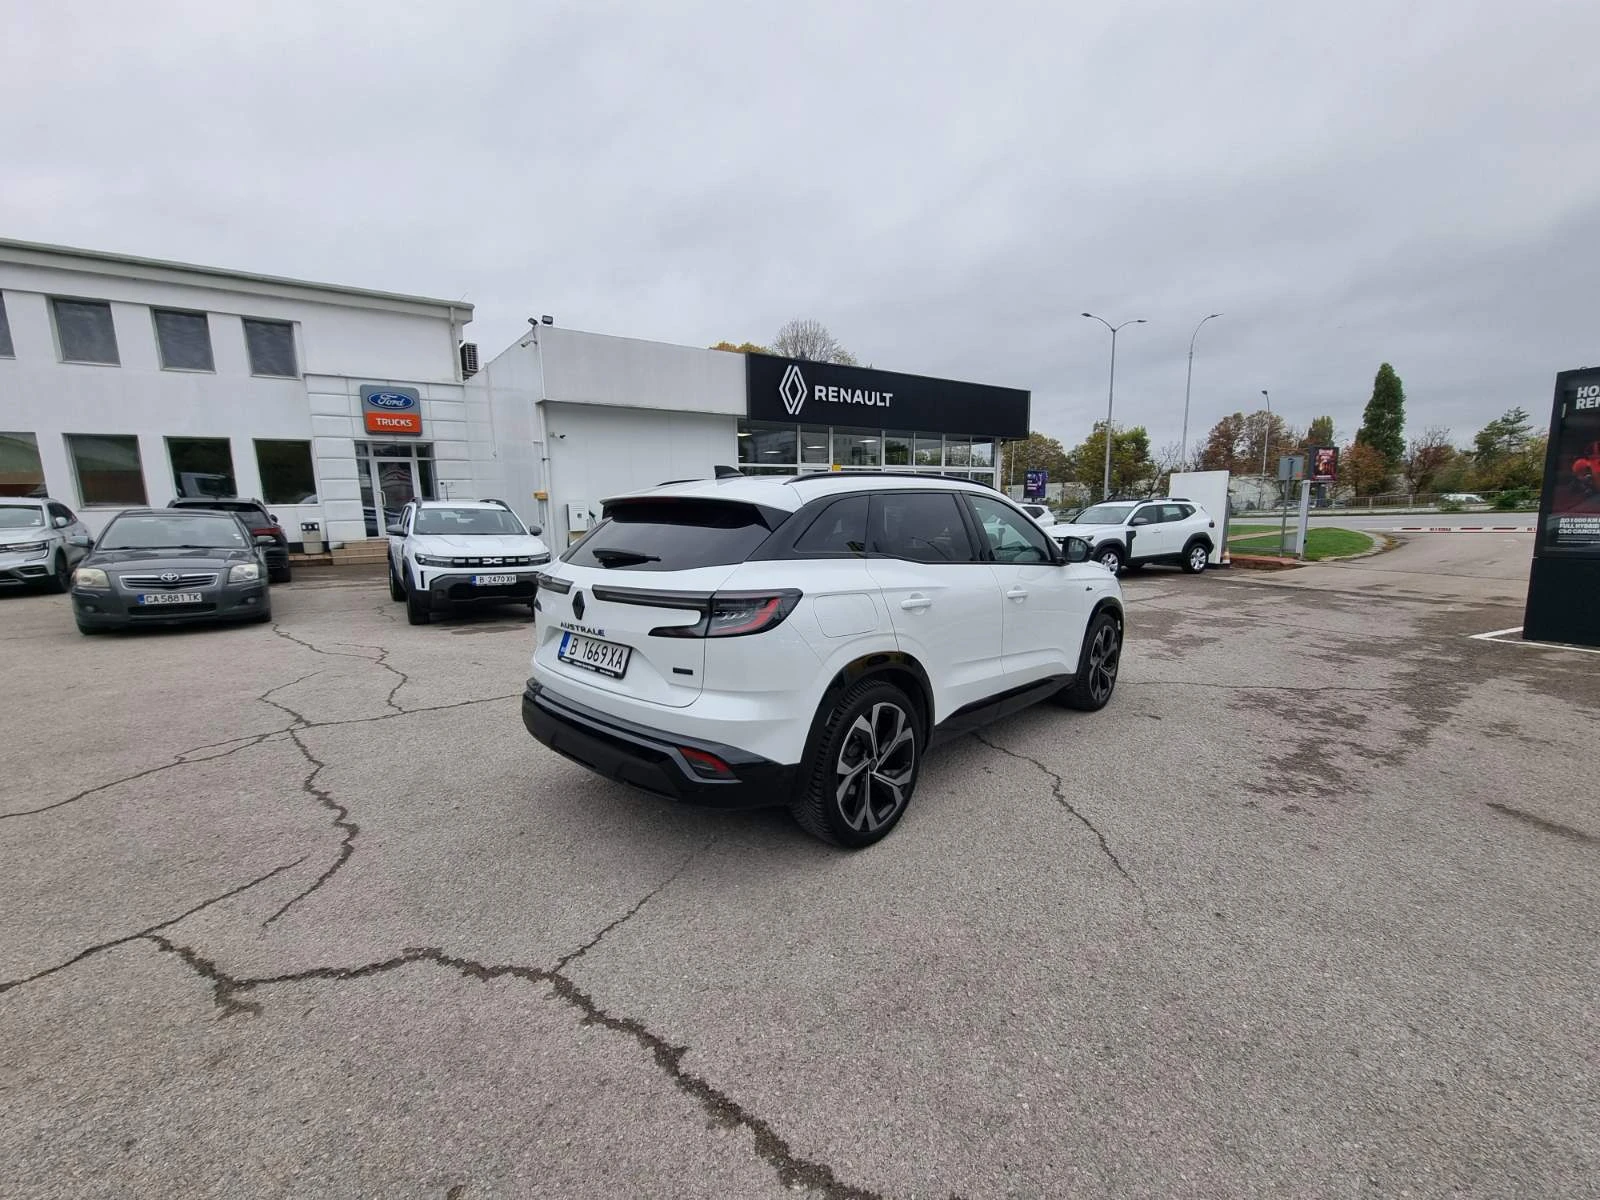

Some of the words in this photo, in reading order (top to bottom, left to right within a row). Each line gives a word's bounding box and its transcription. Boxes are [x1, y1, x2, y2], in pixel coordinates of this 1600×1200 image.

[377, 394, 406, 407] Ford
[814, 385, 894, 407] RENAULT
[375, 417, 413, 427] TRUCKS
[560, 622, 605, 637] AUSTRALE
